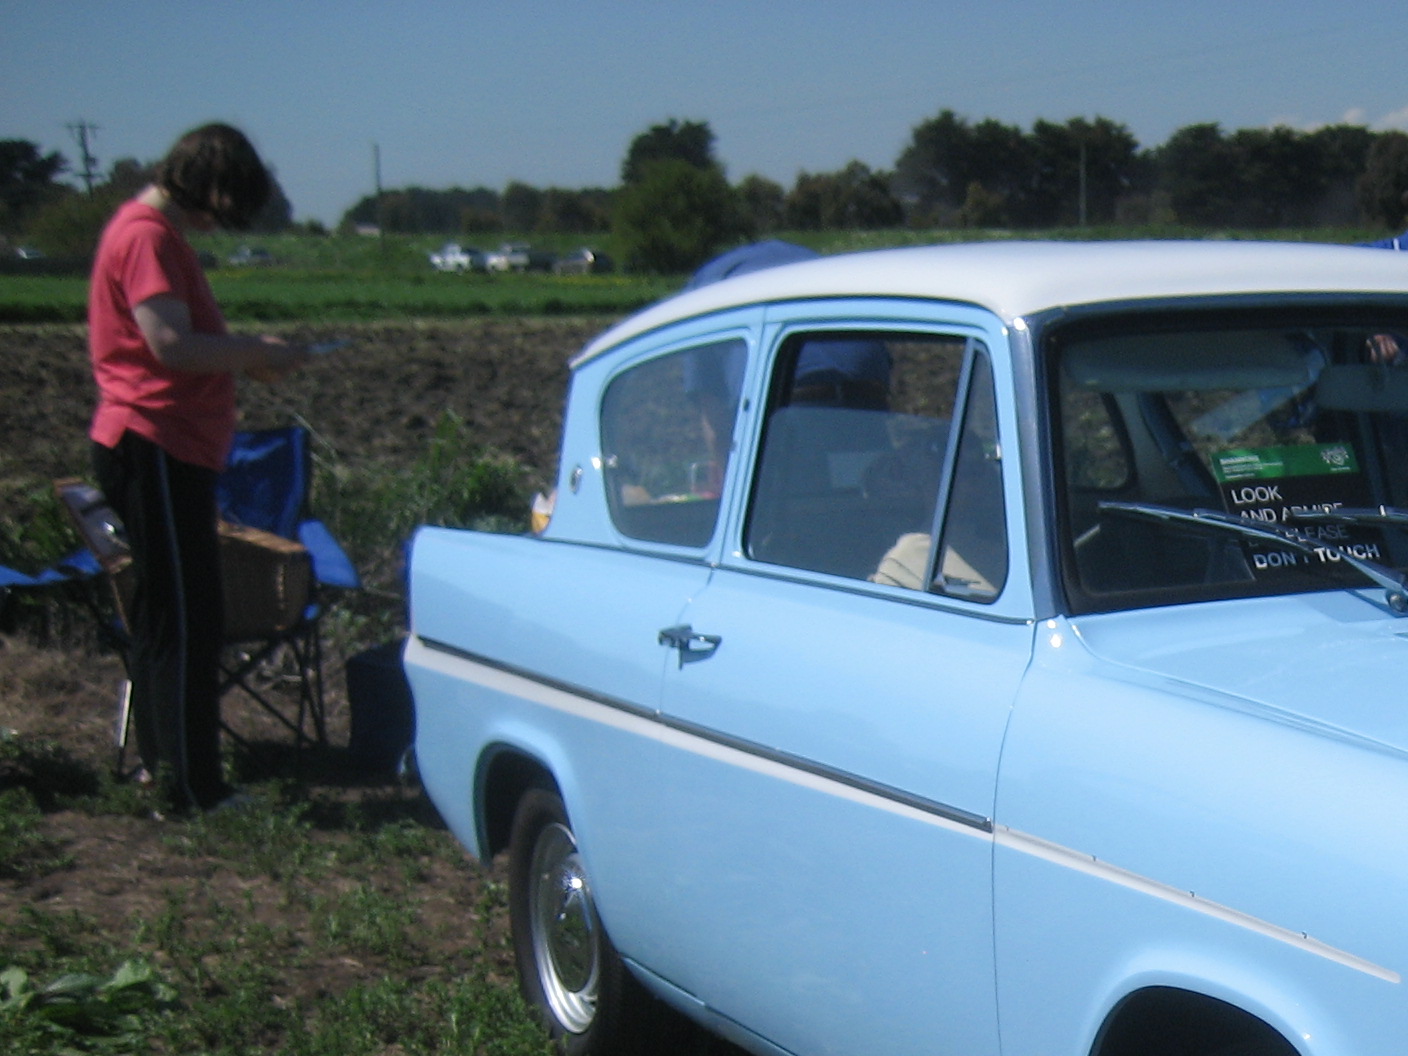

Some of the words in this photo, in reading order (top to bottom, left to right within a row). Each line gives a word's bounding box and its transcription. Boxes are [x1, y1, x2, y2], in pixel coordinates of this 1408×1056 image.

[1231, 485, 1283, 505] LOOK
[1240, 508, 1277, 524] AND
[1282, 502, 1343, 522] ADR
[1253, 551, 1309, 569] DON
